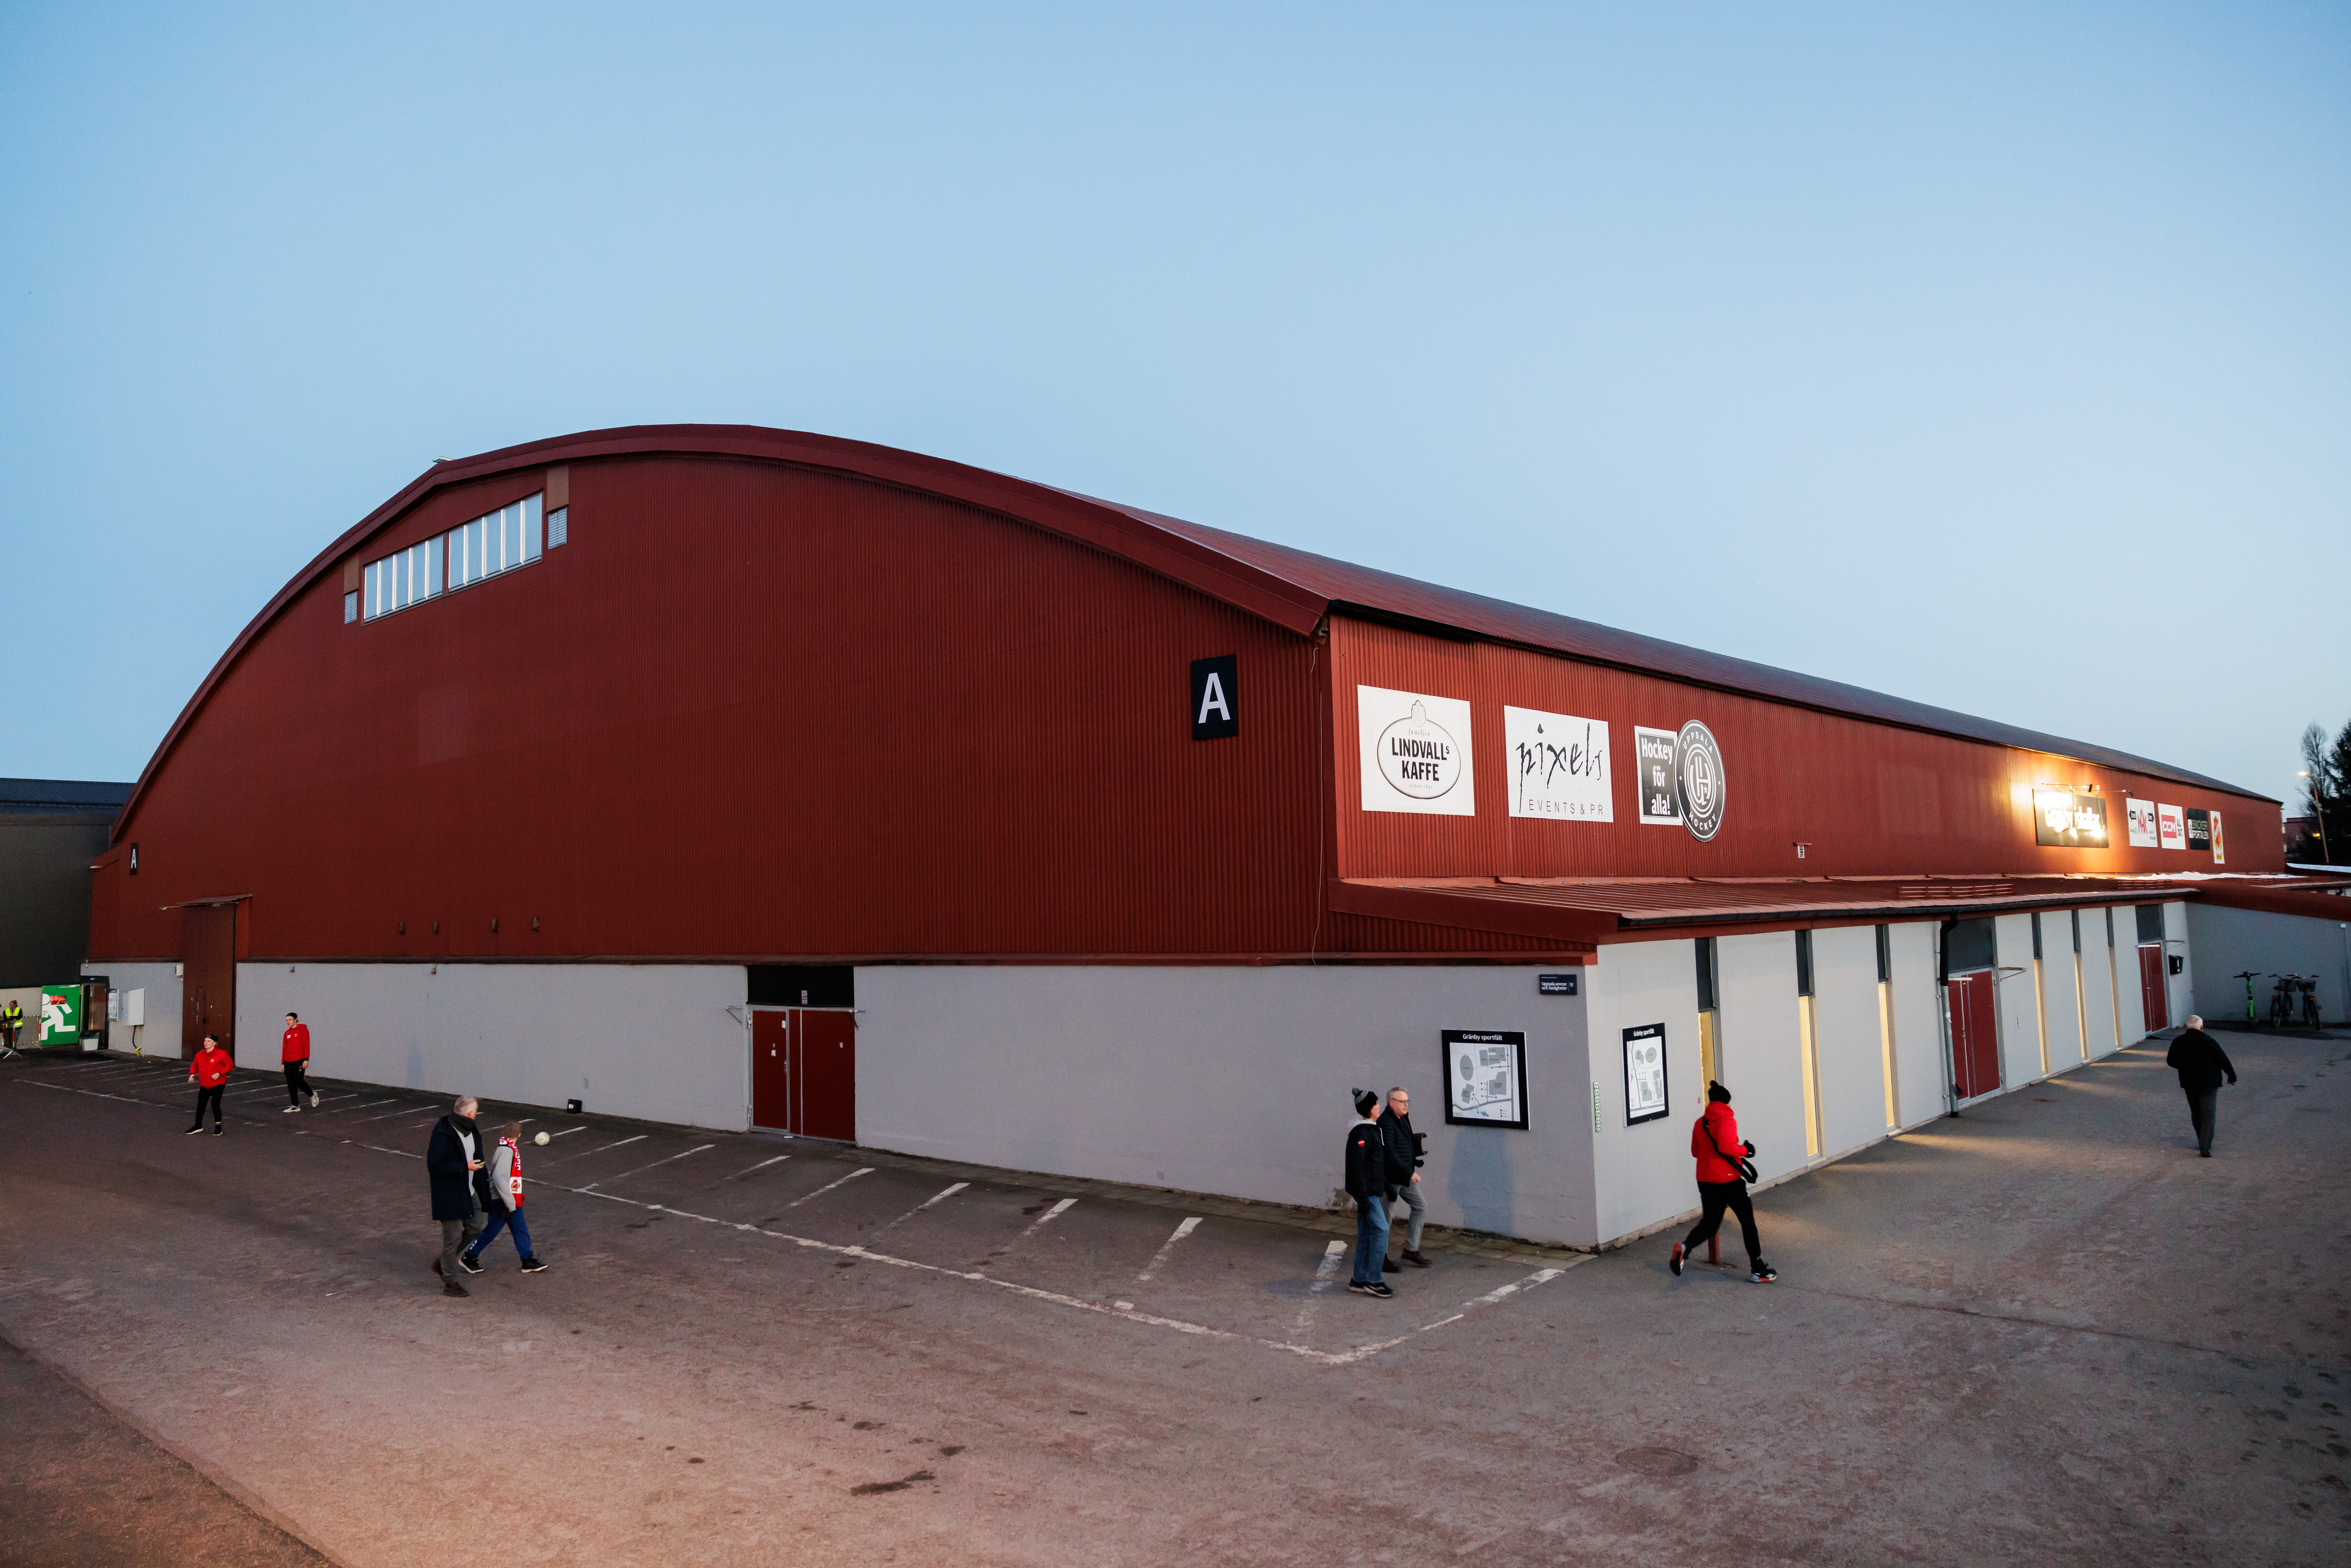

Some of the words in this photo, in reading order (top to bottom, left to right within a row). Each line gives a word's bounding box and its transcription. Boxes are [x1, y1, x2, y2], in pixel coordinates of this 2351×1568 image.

[1198, 672, 1231, 724] A
[1407, 728, 1430, 737] familjen
[1683, 731, 1713, 753] UPPSALA
[1641, 737, 1673, 765] Hockey
[1402, 760, 1440, 781] KAFFE
[1515, 722, 1603, 814] pixels
[1652, 765, 1665, 787] för
[1529, 799, 1575, 814] EVENTS
[1580, 804, 1585, 814] &
[1590, 804, 1603, 815] PR
[1651, 793, 1671, 816] alla!
[1689, 811, 1717, 831] HOCKEY
[2163, 821, 2176, 833] CCM
[130, 848, 137, 869] A
